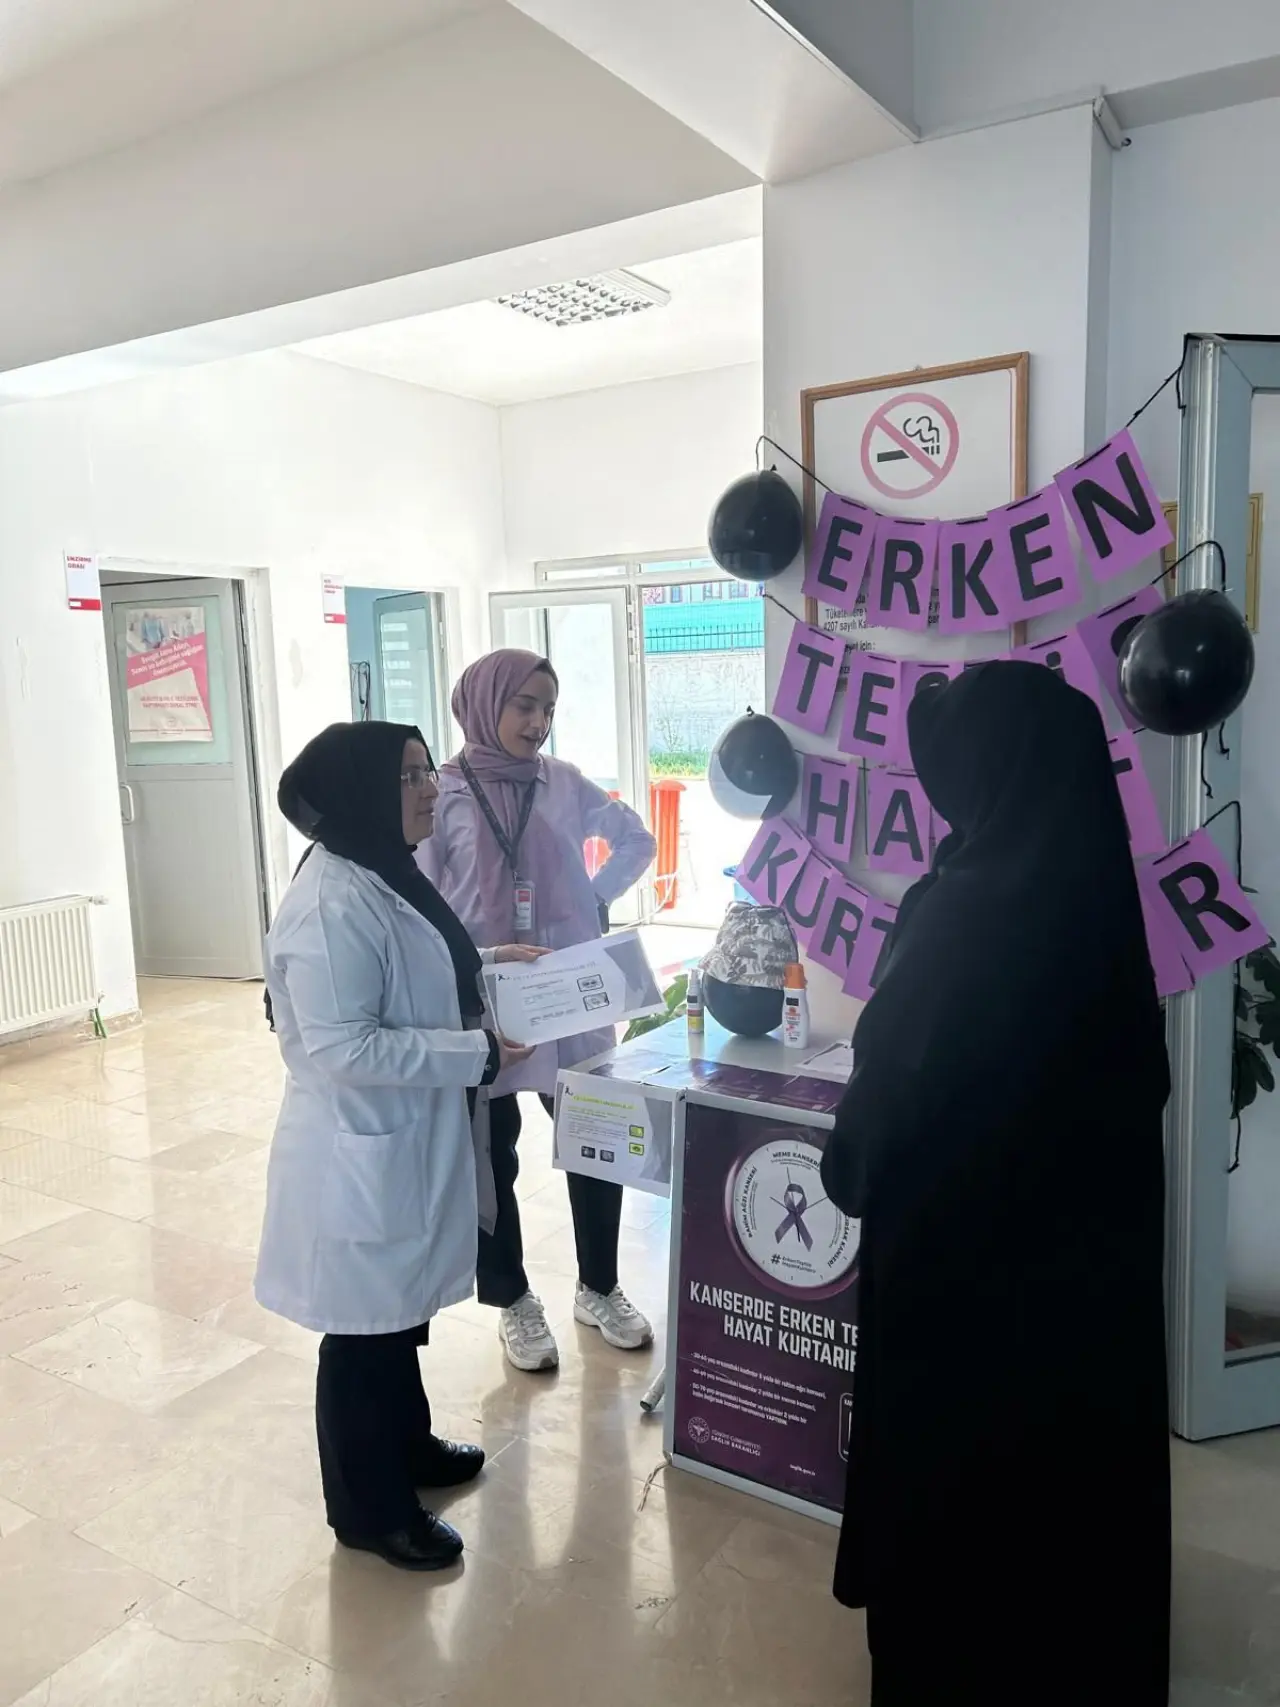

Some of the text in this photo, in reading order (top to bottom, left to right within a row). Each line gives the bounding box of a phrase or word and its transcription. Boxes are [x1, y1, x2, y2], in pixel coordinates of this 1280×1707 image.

[817, 451, 1156, 619] ERKEN
[792, 1152, 820, 1168] KANSERİ
[743, 1165, 758, 1194] KANSERİ
[690, 1280, 775, 1324] KANSERDE
[779, 1305, 834, 1340] ERKEN
[724, 1314, 773, 1348] HAYAT
